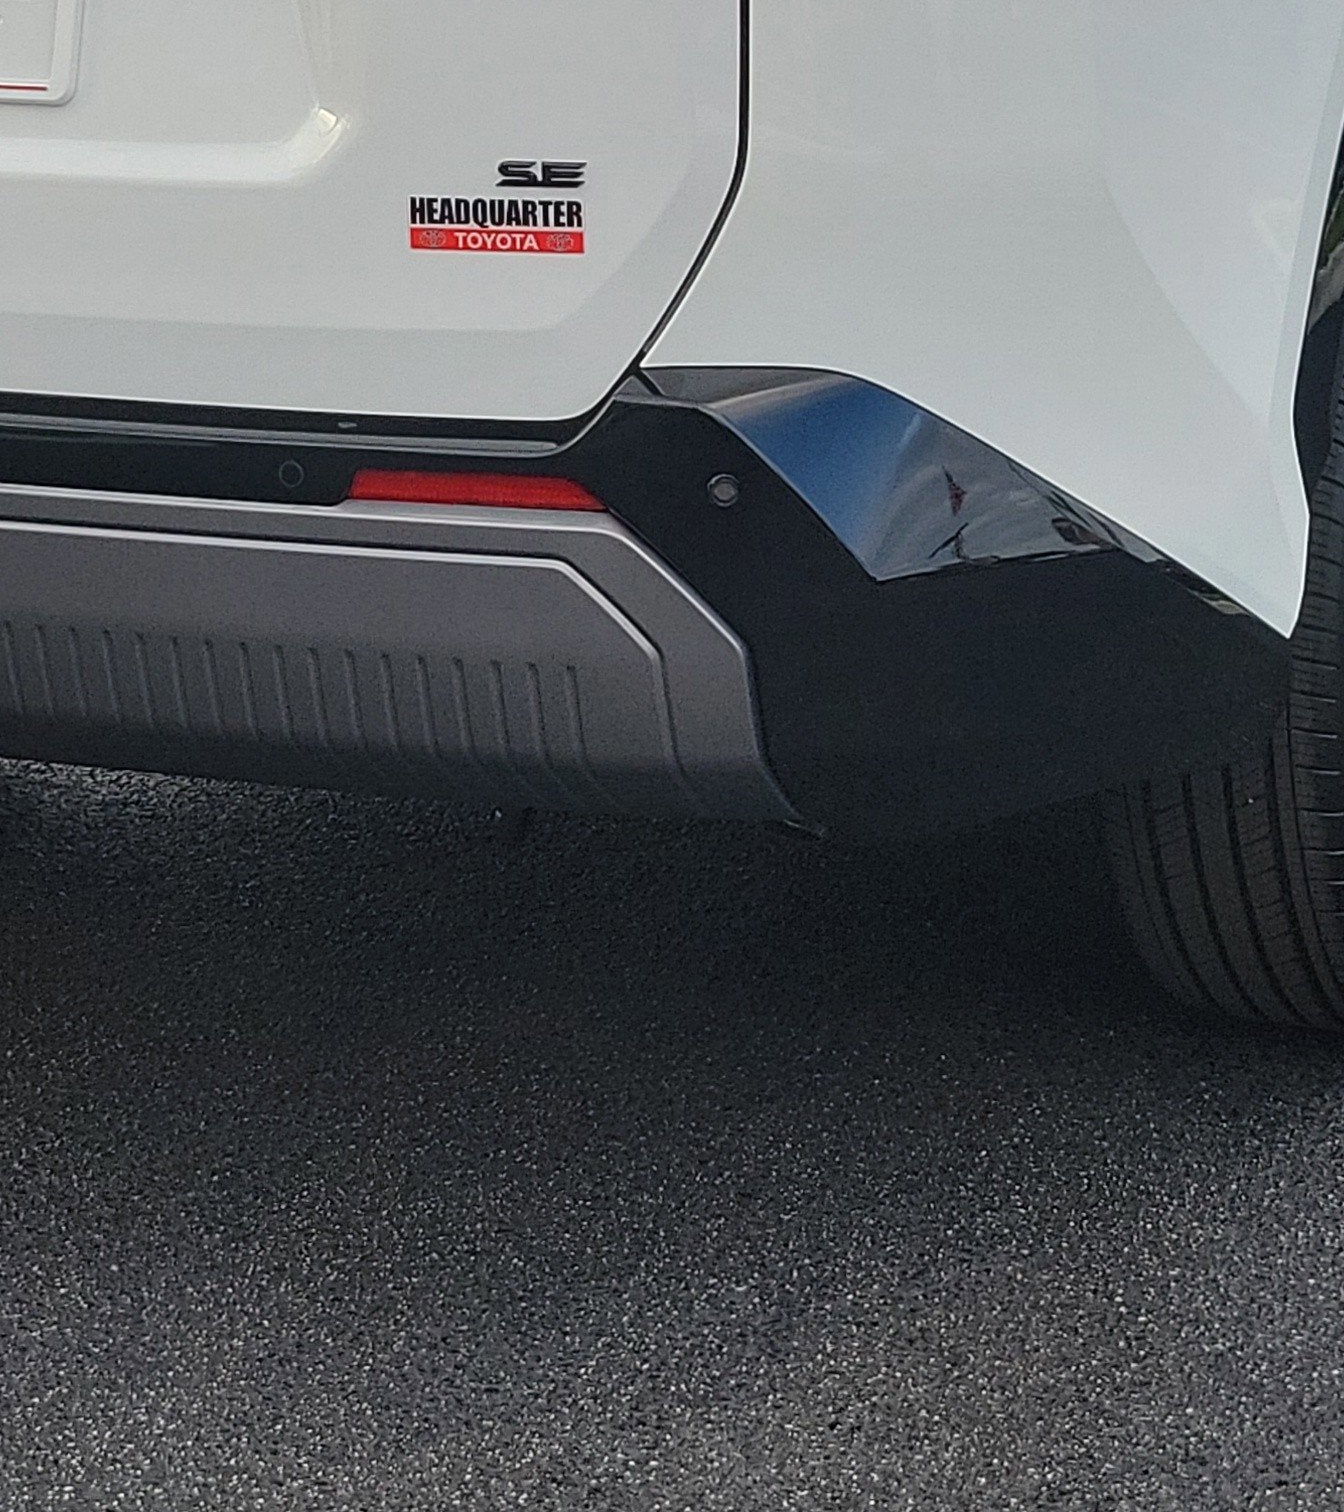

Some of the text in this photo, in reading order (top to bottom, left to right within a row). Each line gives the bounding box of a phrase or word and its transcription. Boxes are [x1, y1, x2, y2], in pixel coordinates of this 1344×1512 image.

[496, 159, 587, 188] SE
[409, 196, 583, 228] HEADQUARTER
[453, 232, 540, 251] TOYOTA
